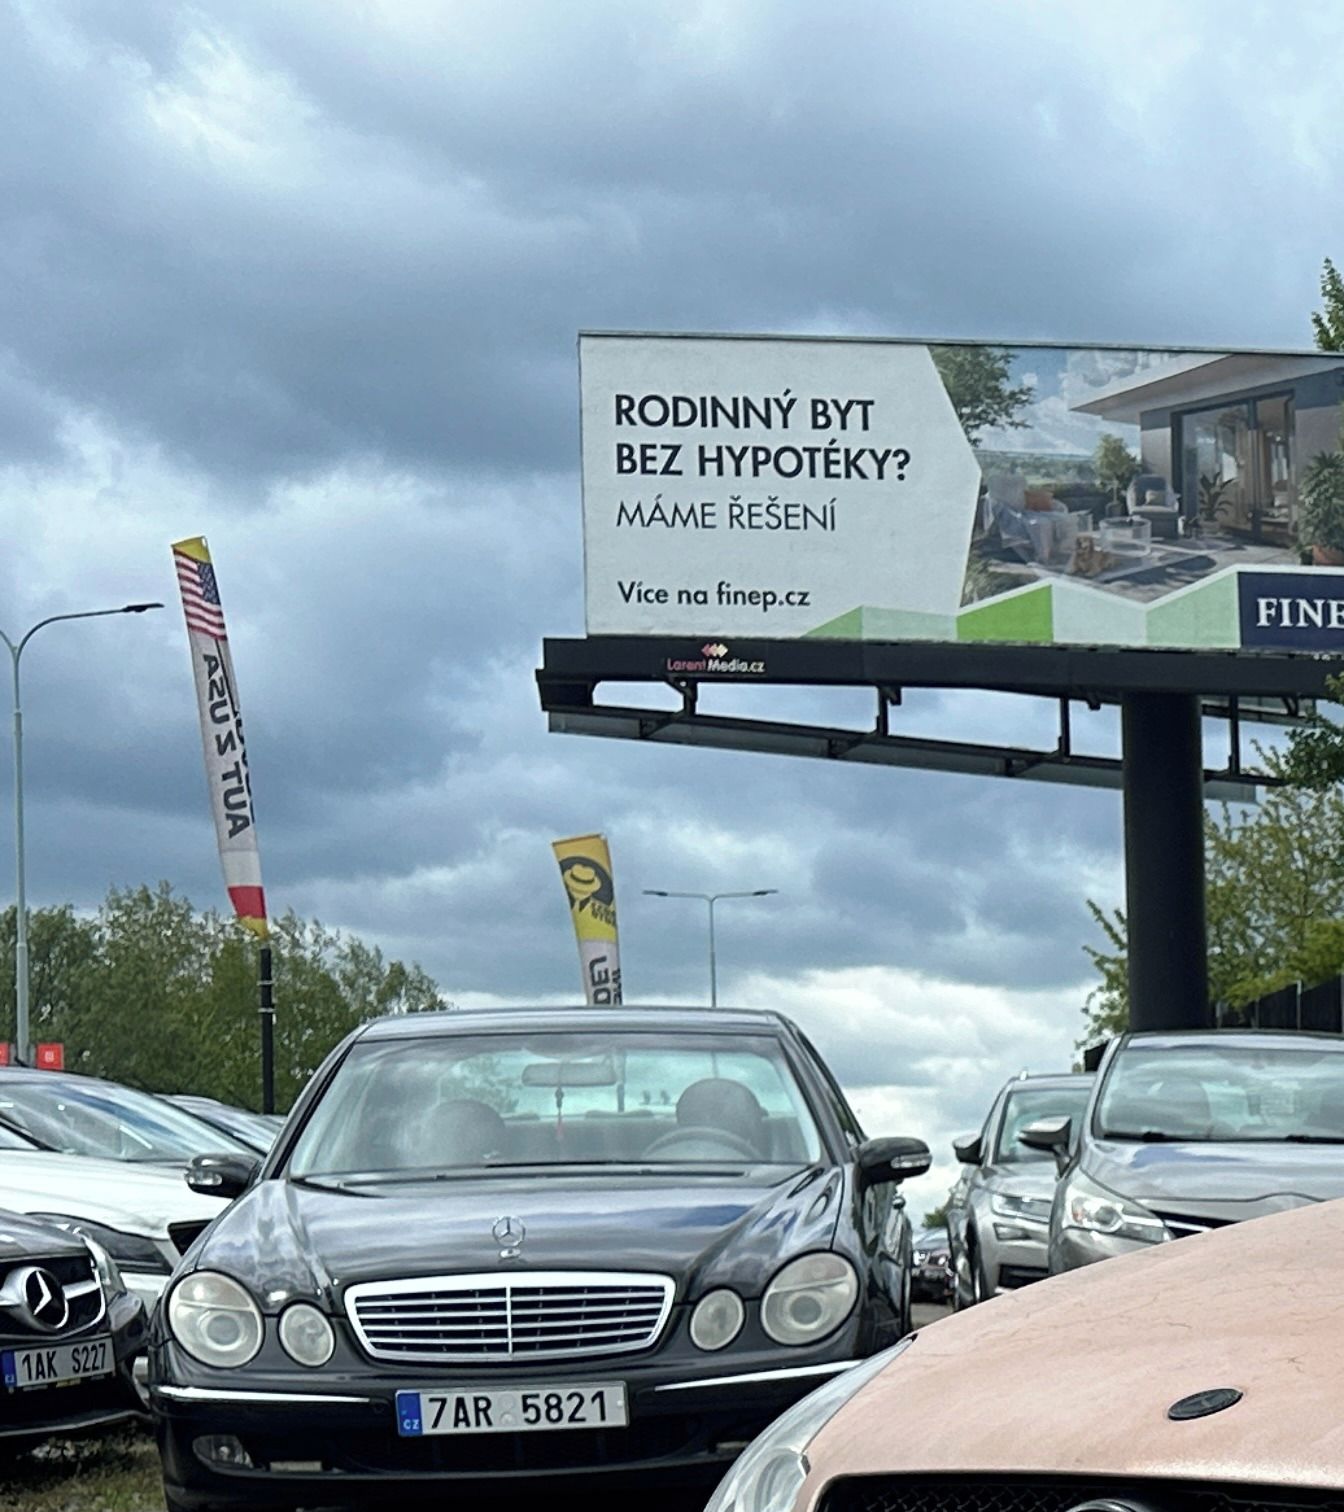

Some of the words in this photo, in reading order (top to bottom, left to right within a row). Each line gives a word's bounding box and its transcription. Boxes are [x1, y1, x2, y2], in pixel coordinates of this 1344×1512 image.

[615, 388, 798, 430] RODINNÝ
[811, 398, 875, 431] BYT
[616, 442, 683, 476] BEZ
[699, 438, 911, 481] HYPOTÉKY?
[616, 493, 718, 529] MÁME
[728, 494, 837, 531] ŘEŠENÍ
[617, 580, 669, 604] Více
[677, 587, 708, 605] na
[716, 580, 811, 612] finep.cz
[21, 1350, 58, 1381] 1AK
[72, 1342, 106, 1374] S227
[428, 1396, 494, 1430] 7AR
[521, 1390, 607, 1425] 5821
